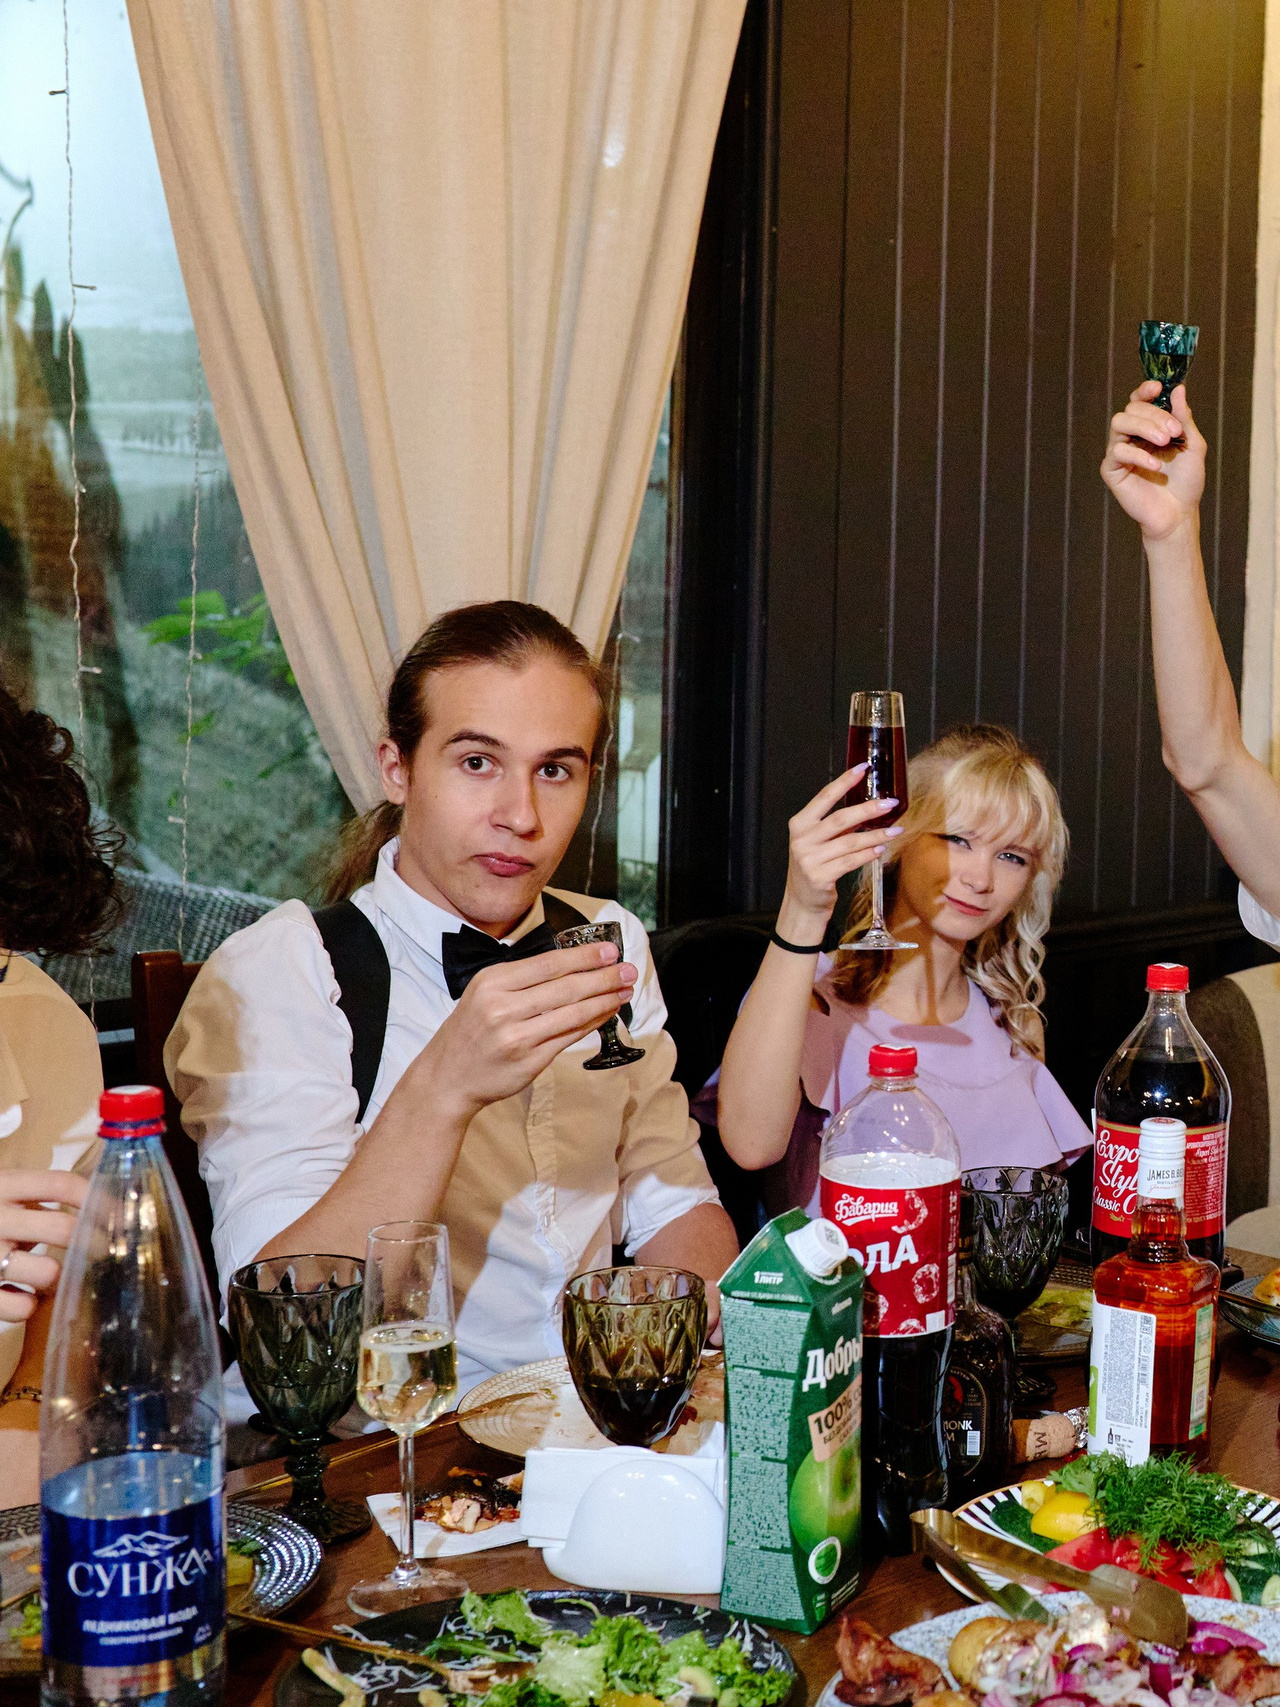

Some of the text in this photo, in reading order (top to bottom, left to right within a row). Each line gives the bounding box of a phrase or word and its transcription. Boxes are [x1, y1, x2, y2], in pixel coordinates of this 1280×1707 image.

[1097, 1129, 1140, 1174] Expo
[1098, 1159, 1139, 1198] Styl
[1147, 1169, 1170, 1181] JAMES
[834, 1193, 899, 1222] Бавария
[759, 1275, 784, 1285] ЛИТР
[802, 1336, 863, 1393] Добры
[814, 1392, 852, 1435] 100%
[67, 1547, 213, 1598] СУНЖА
